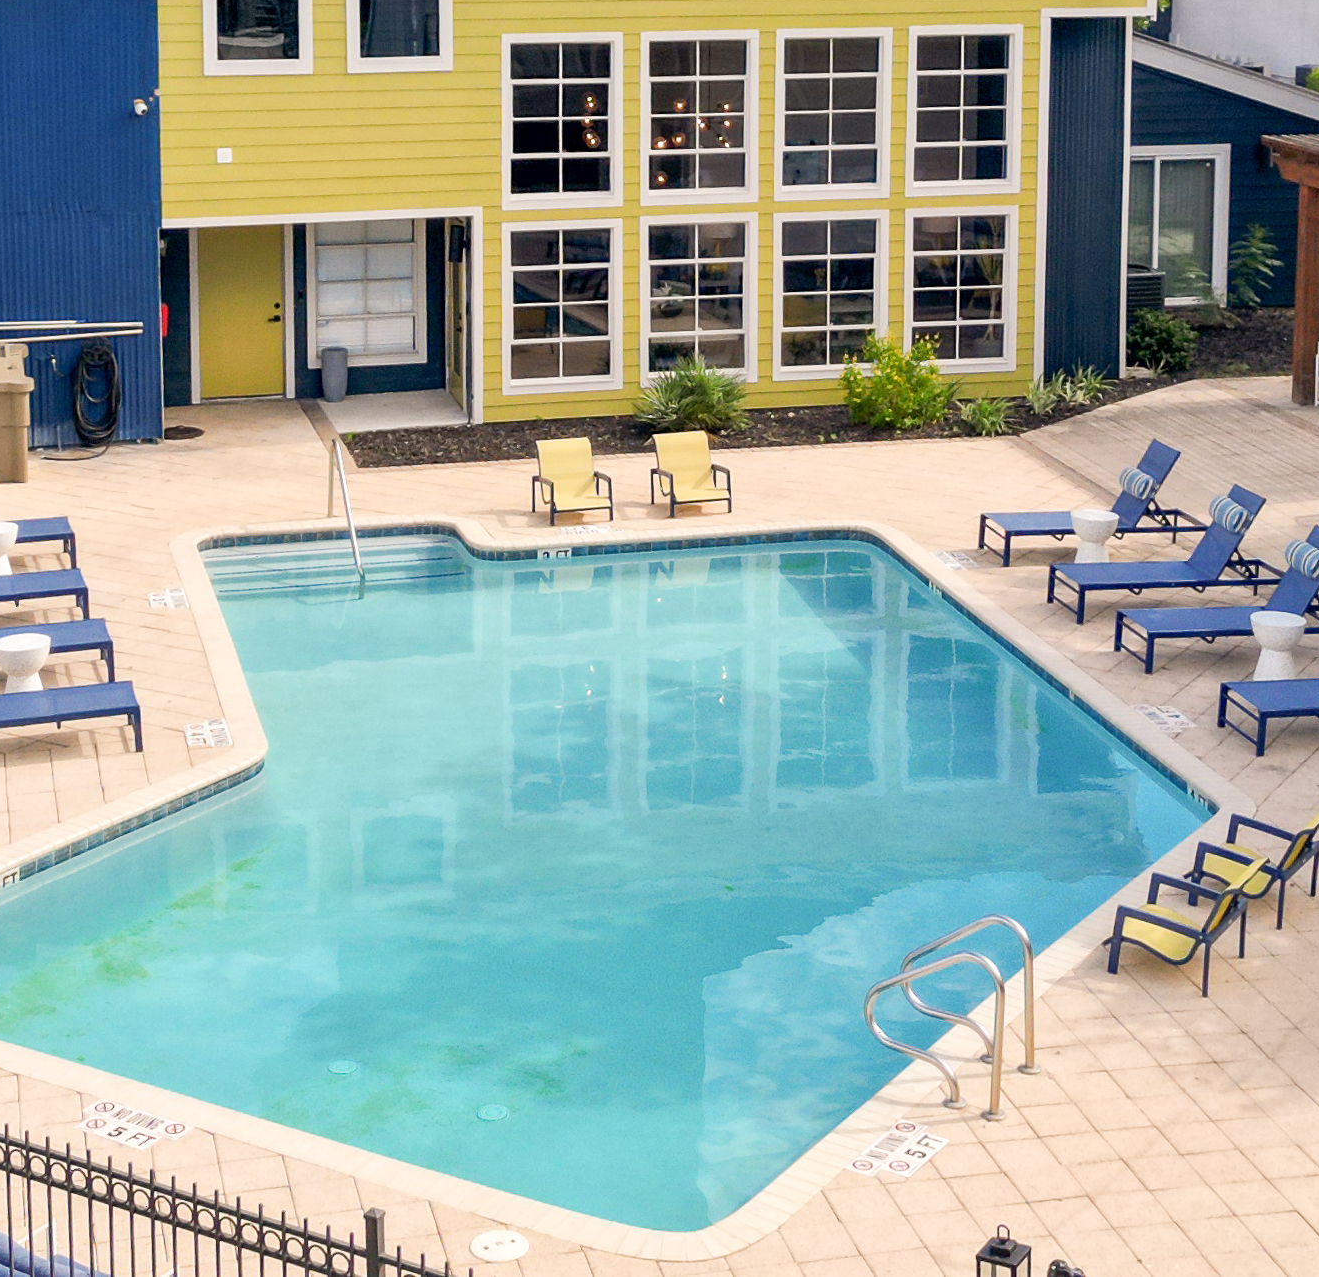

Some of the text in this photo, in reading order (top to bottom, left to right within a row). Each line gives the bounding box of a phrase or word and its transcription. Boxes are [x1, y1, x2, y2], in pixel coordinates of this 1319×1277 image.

[112, 1107, 165, 1130] NO DIVING
[107, 1126, 157, 1147] 5 FT
[904, 1134, 943, 1159] 5 FT
